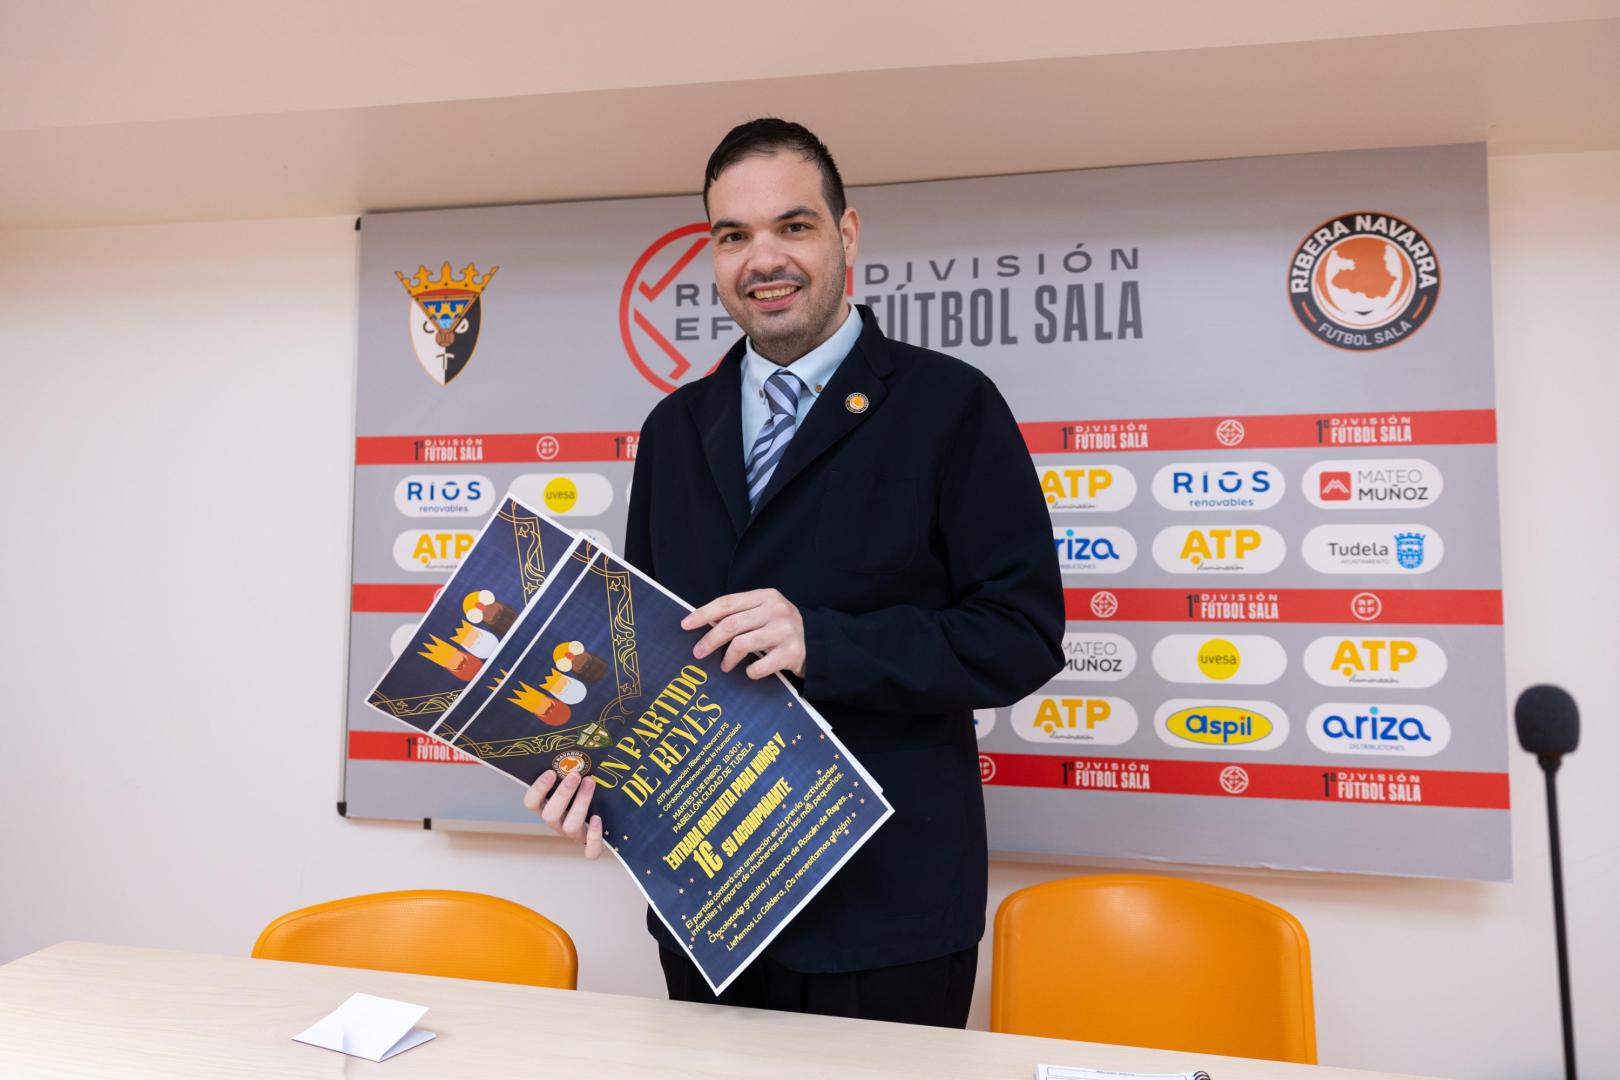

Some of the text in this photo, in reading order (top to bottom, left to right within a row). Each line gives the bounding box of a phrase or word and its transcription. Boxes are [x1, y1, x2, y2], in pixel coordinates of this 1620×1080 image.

[865, 242, 1139, 285] DIVISIÓN
[1291, 215, 1438, 293] RIBERA NAVARRA
[1034, 280, 1143, 344] SALA
[1318, 320, 1412, 346] FUTBOL SALA
[1120, 432, 1148, 448] SALA
[1380, 424, 1413, 443] SALA
[460, 445, 483, 461] SALA
[1041, 468, 1113, 501] ATP
[1357, 469, 1423, 485] MATEO
[1358, 484, 1428, 502] MUÑOZ
[419, 504, 469, 513] renovables
[546, 489, 576, 500] uvesa
[1189, 498, 1254, 507] renovables
[413, 533, 475, 563] ATP
[1053, 529, 1120, 560] riza
[1179, 529, 1262, 563] ATP
[1327, 542, 1389, 556] Tudela
[1249, 602, 1279, 619] SALA
[1200, 653, 1237, 665] uvesa
[1330, 640, 1418, 675] ATP
[592, 664, 707, 789] UN PARTIDO
[1032, 697, 1112, 732] ATP
[1185, 714, 1252, 743] aspil
[1322, 706, 1432, 742] ariza
[620, 693, 721, 807] DE REYES
[656, 792, 666, 805] ATP
[687, 750, 705, 768] Ribera
[702, 729, 723, 752] Navarra
[719, 721, 729, 731] FS
[662, 789, 683, 811] Córdoba
[680, 763, 706, 791] Patrimonio
[704, 756, 712, 765] de
[713, 722, 741, 753] Humanidad
[672, 794, 694, 820] MARTES
[692, 790, 698, 798] 6
[695, 782, 706, 793] DE
[703, 764, 721, 785] ENERO
[735, 740, 742, 748] H
[672, 742, 754, 833] PABELLÓN CIUDAD DE TUDELA
[1120, 772, 1151, 790] SALA
[1388, 782, 1422, 803] SALA
[666, 829, 703, 871] ENTRADA
[697, 788, 738, 834] GRATUITA
[729, 767, 757, 797] PARA
[772, 731, 786, 748] Y
[692, 776, 792, 879] 1€ SU ACOMPAÑANTE
[684, 919, 693, 929] El
[692, 899, 714, 924] partido
[712, 875, 734, 901] contará
[733, 865, 744, 878] con
[743, 835, 772, 867] animación
[770, 827, 779, 837] en
[776, 820, 785, 829] la
[803, 763, 837, 801] actividades
[690, 907, 718, 936] infantiles
[716, 902, 722, 911] y
[720, 880, 742, 905] reparto
[741, 872, 750, 882] de
[777, 825, 793, 844] para
[790, 816, 801, 828] los
[708, 905, 744, 943] Chocolatada
[742, 881, 766, 910] gratuita
[764, 877, 770, 885] y
[768, 854, 792, 879] reparto
[790, 845, 799, 856] de
[818, 815, 828, 825] de
[751, 912, 762, 923] La
[794, 839, 830, 879] necesitamos
